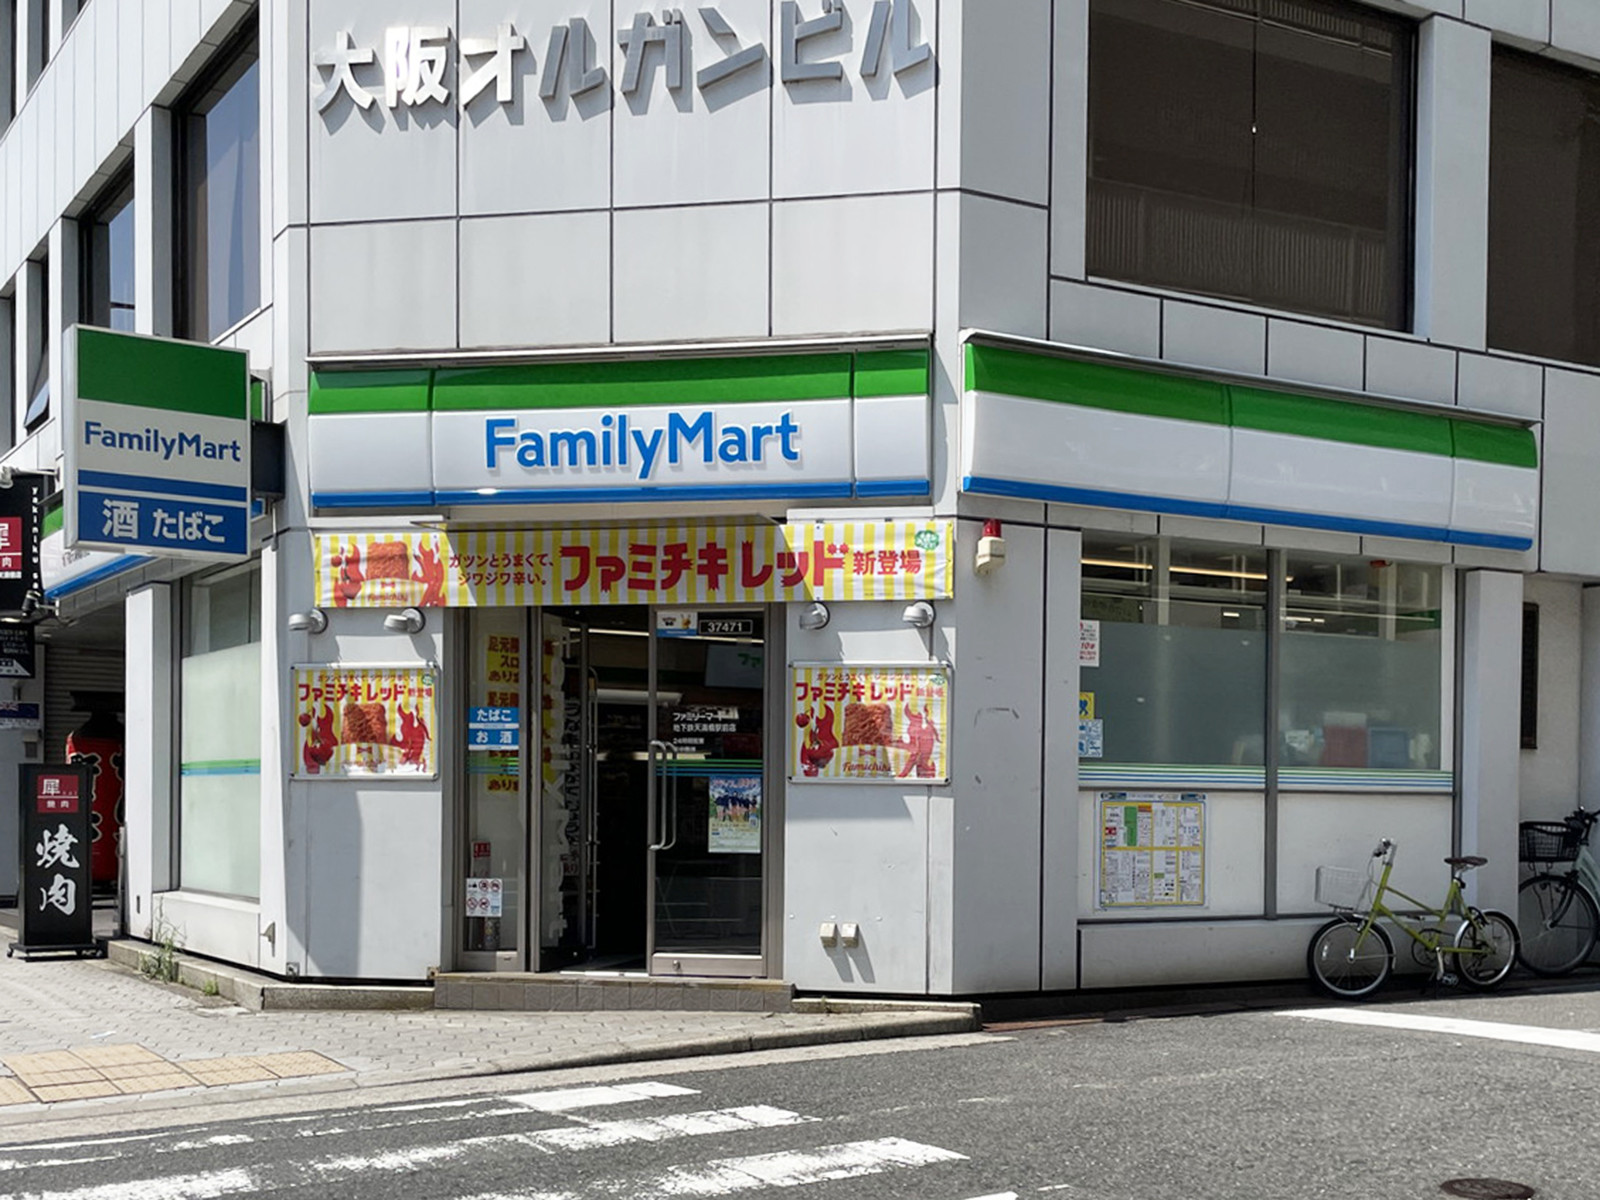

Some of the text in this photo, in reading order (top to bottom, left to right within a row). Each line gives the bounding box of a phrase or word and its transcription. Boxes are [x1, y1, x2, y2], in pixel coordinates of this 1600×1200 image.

[313, 0, 930, 113] 大阪オルガンビル
[85, 421, 241, 461] FamilyMart
[486, 412, 799, 480] FamilyMart
[102, 499, 225, 543] 酒 たばこ
[853, 550, 922, 575] 新登場
[707, 622, 743, 632] 37471
[476, 709, 512, 722] たばこ
[36, 823, 80, 916] 焼肉
